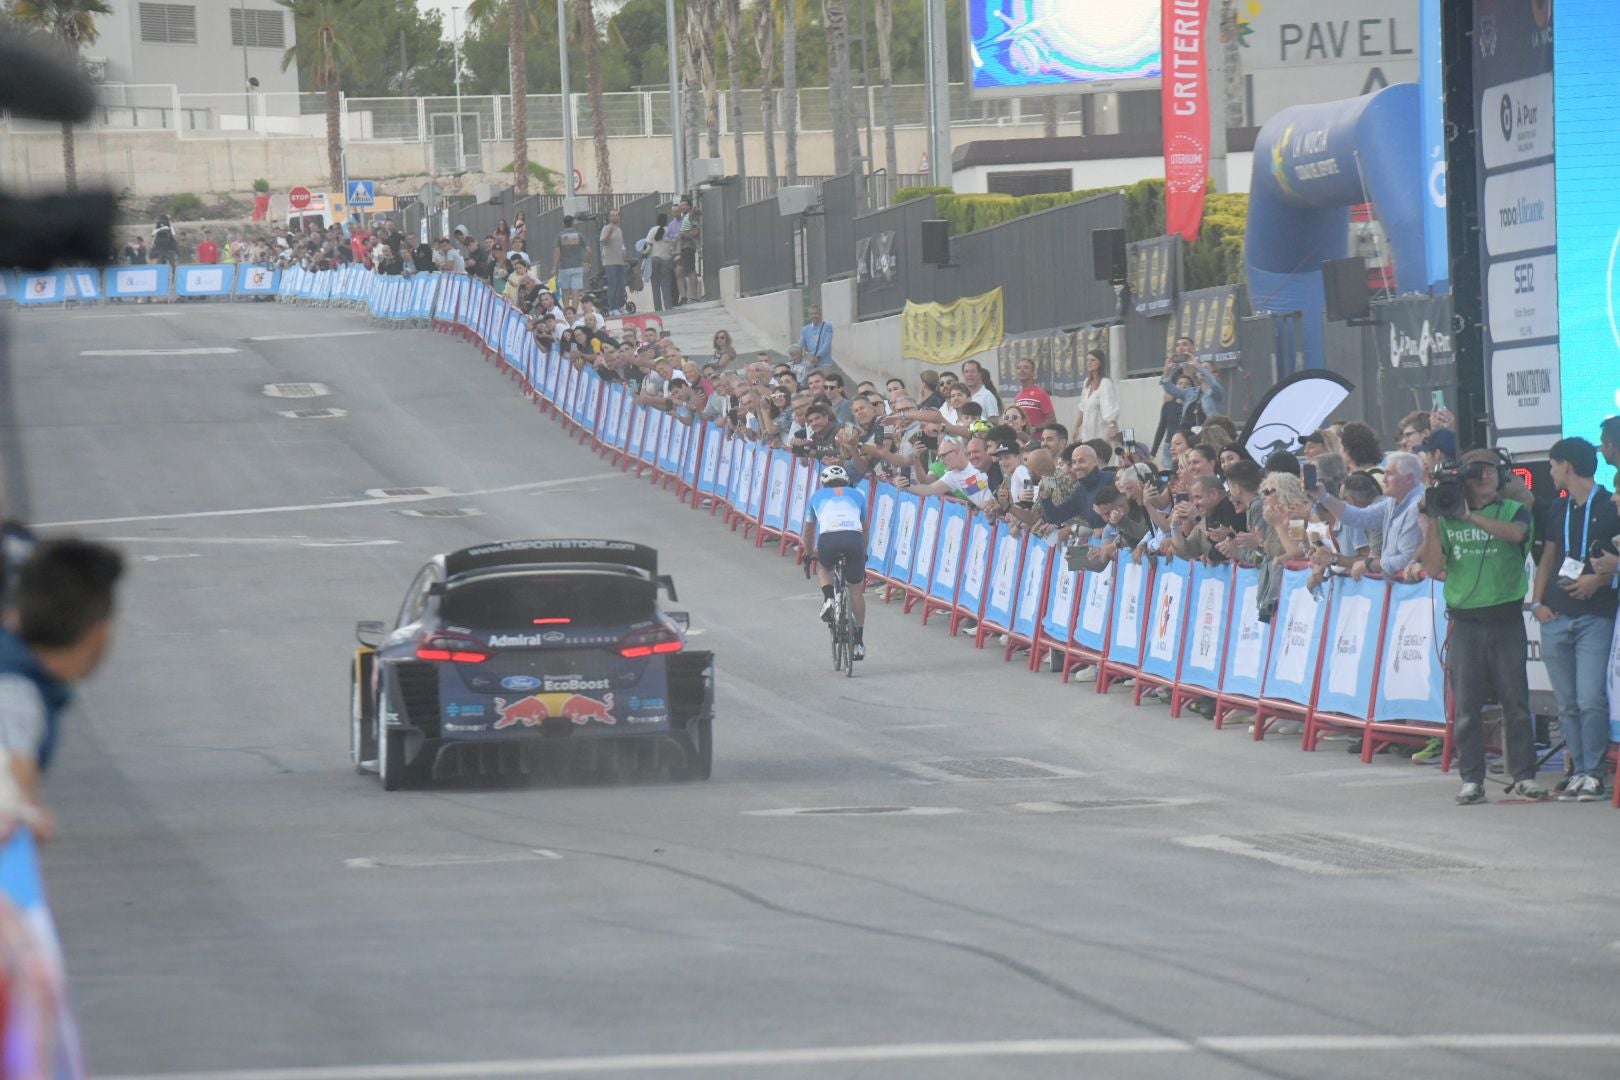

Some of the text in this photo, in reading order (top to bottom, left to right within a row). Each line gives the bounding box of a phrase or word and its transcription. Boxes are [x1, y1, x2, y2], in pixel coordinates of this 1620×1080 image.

[1447, 528, 1494, 542] PRENS
[488, 634, 541, 647] Admiral
[544, 678, 609, 690] EcoBoost
